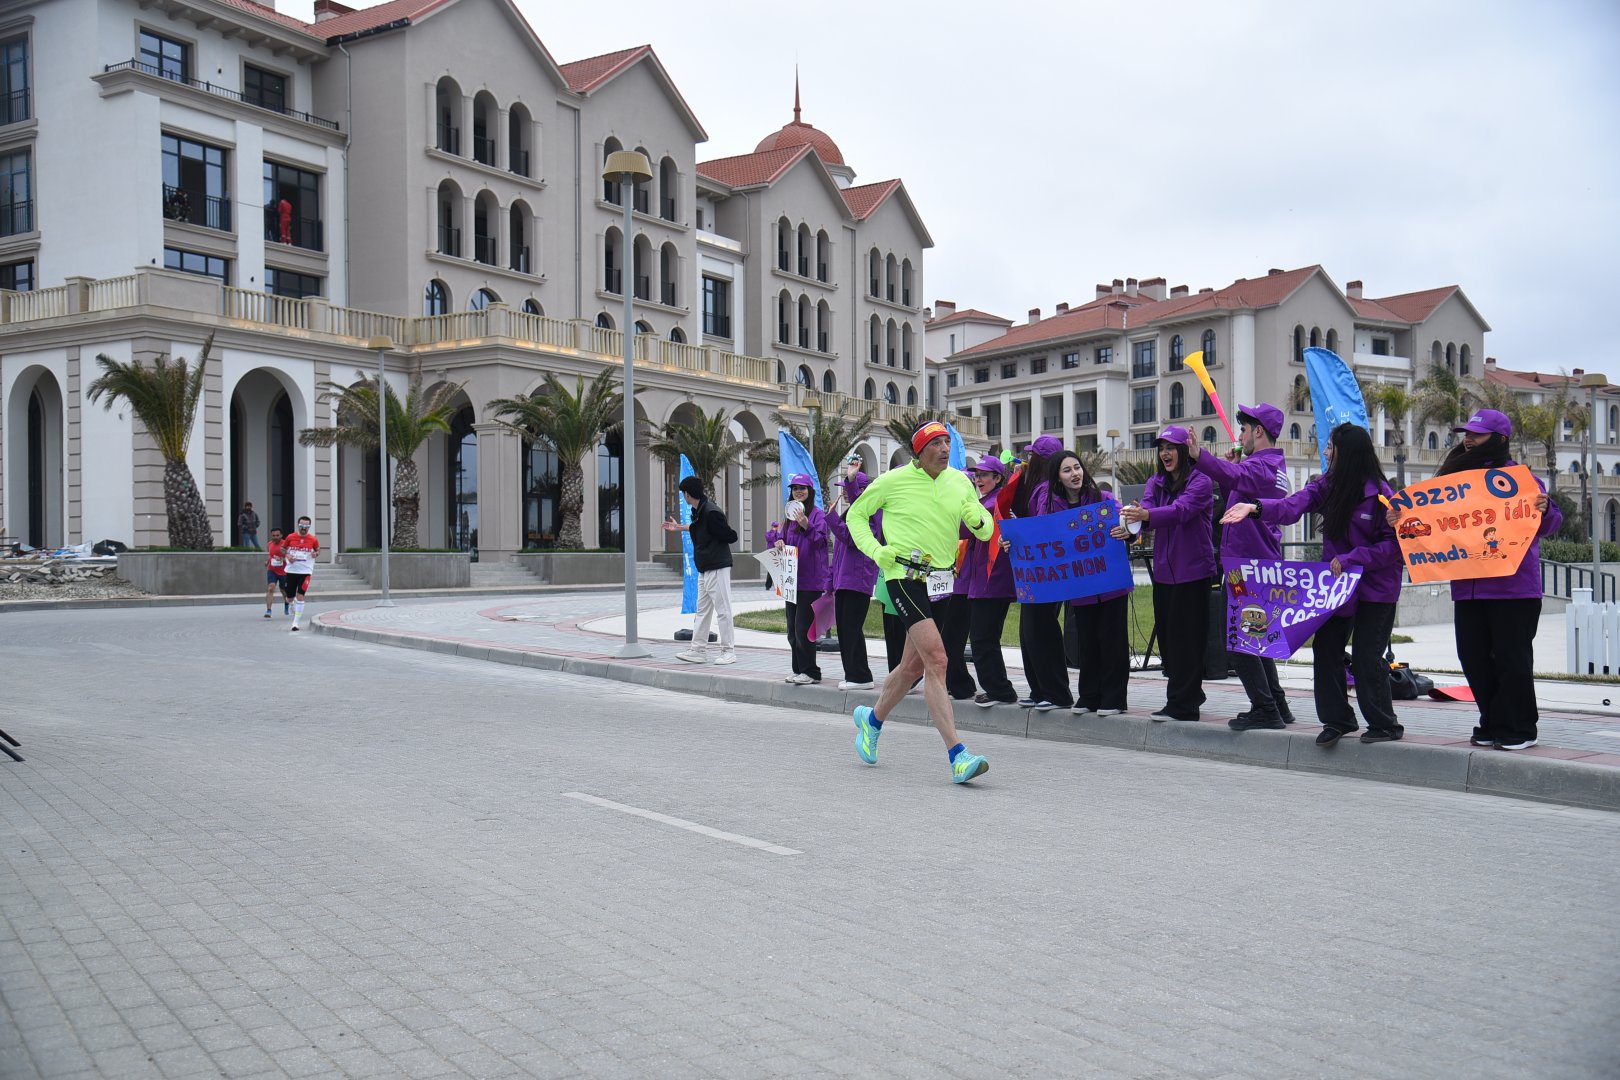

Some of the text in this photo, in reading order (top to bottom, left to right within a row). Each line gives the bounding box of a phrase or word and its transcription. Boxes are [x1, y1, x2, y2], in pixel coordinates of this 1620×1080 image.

[1015, 531, 1106, 561] LET'S GO
[1014, 555, 1107, 583] MARATHON
[932, 581, 949, 593] 4951
